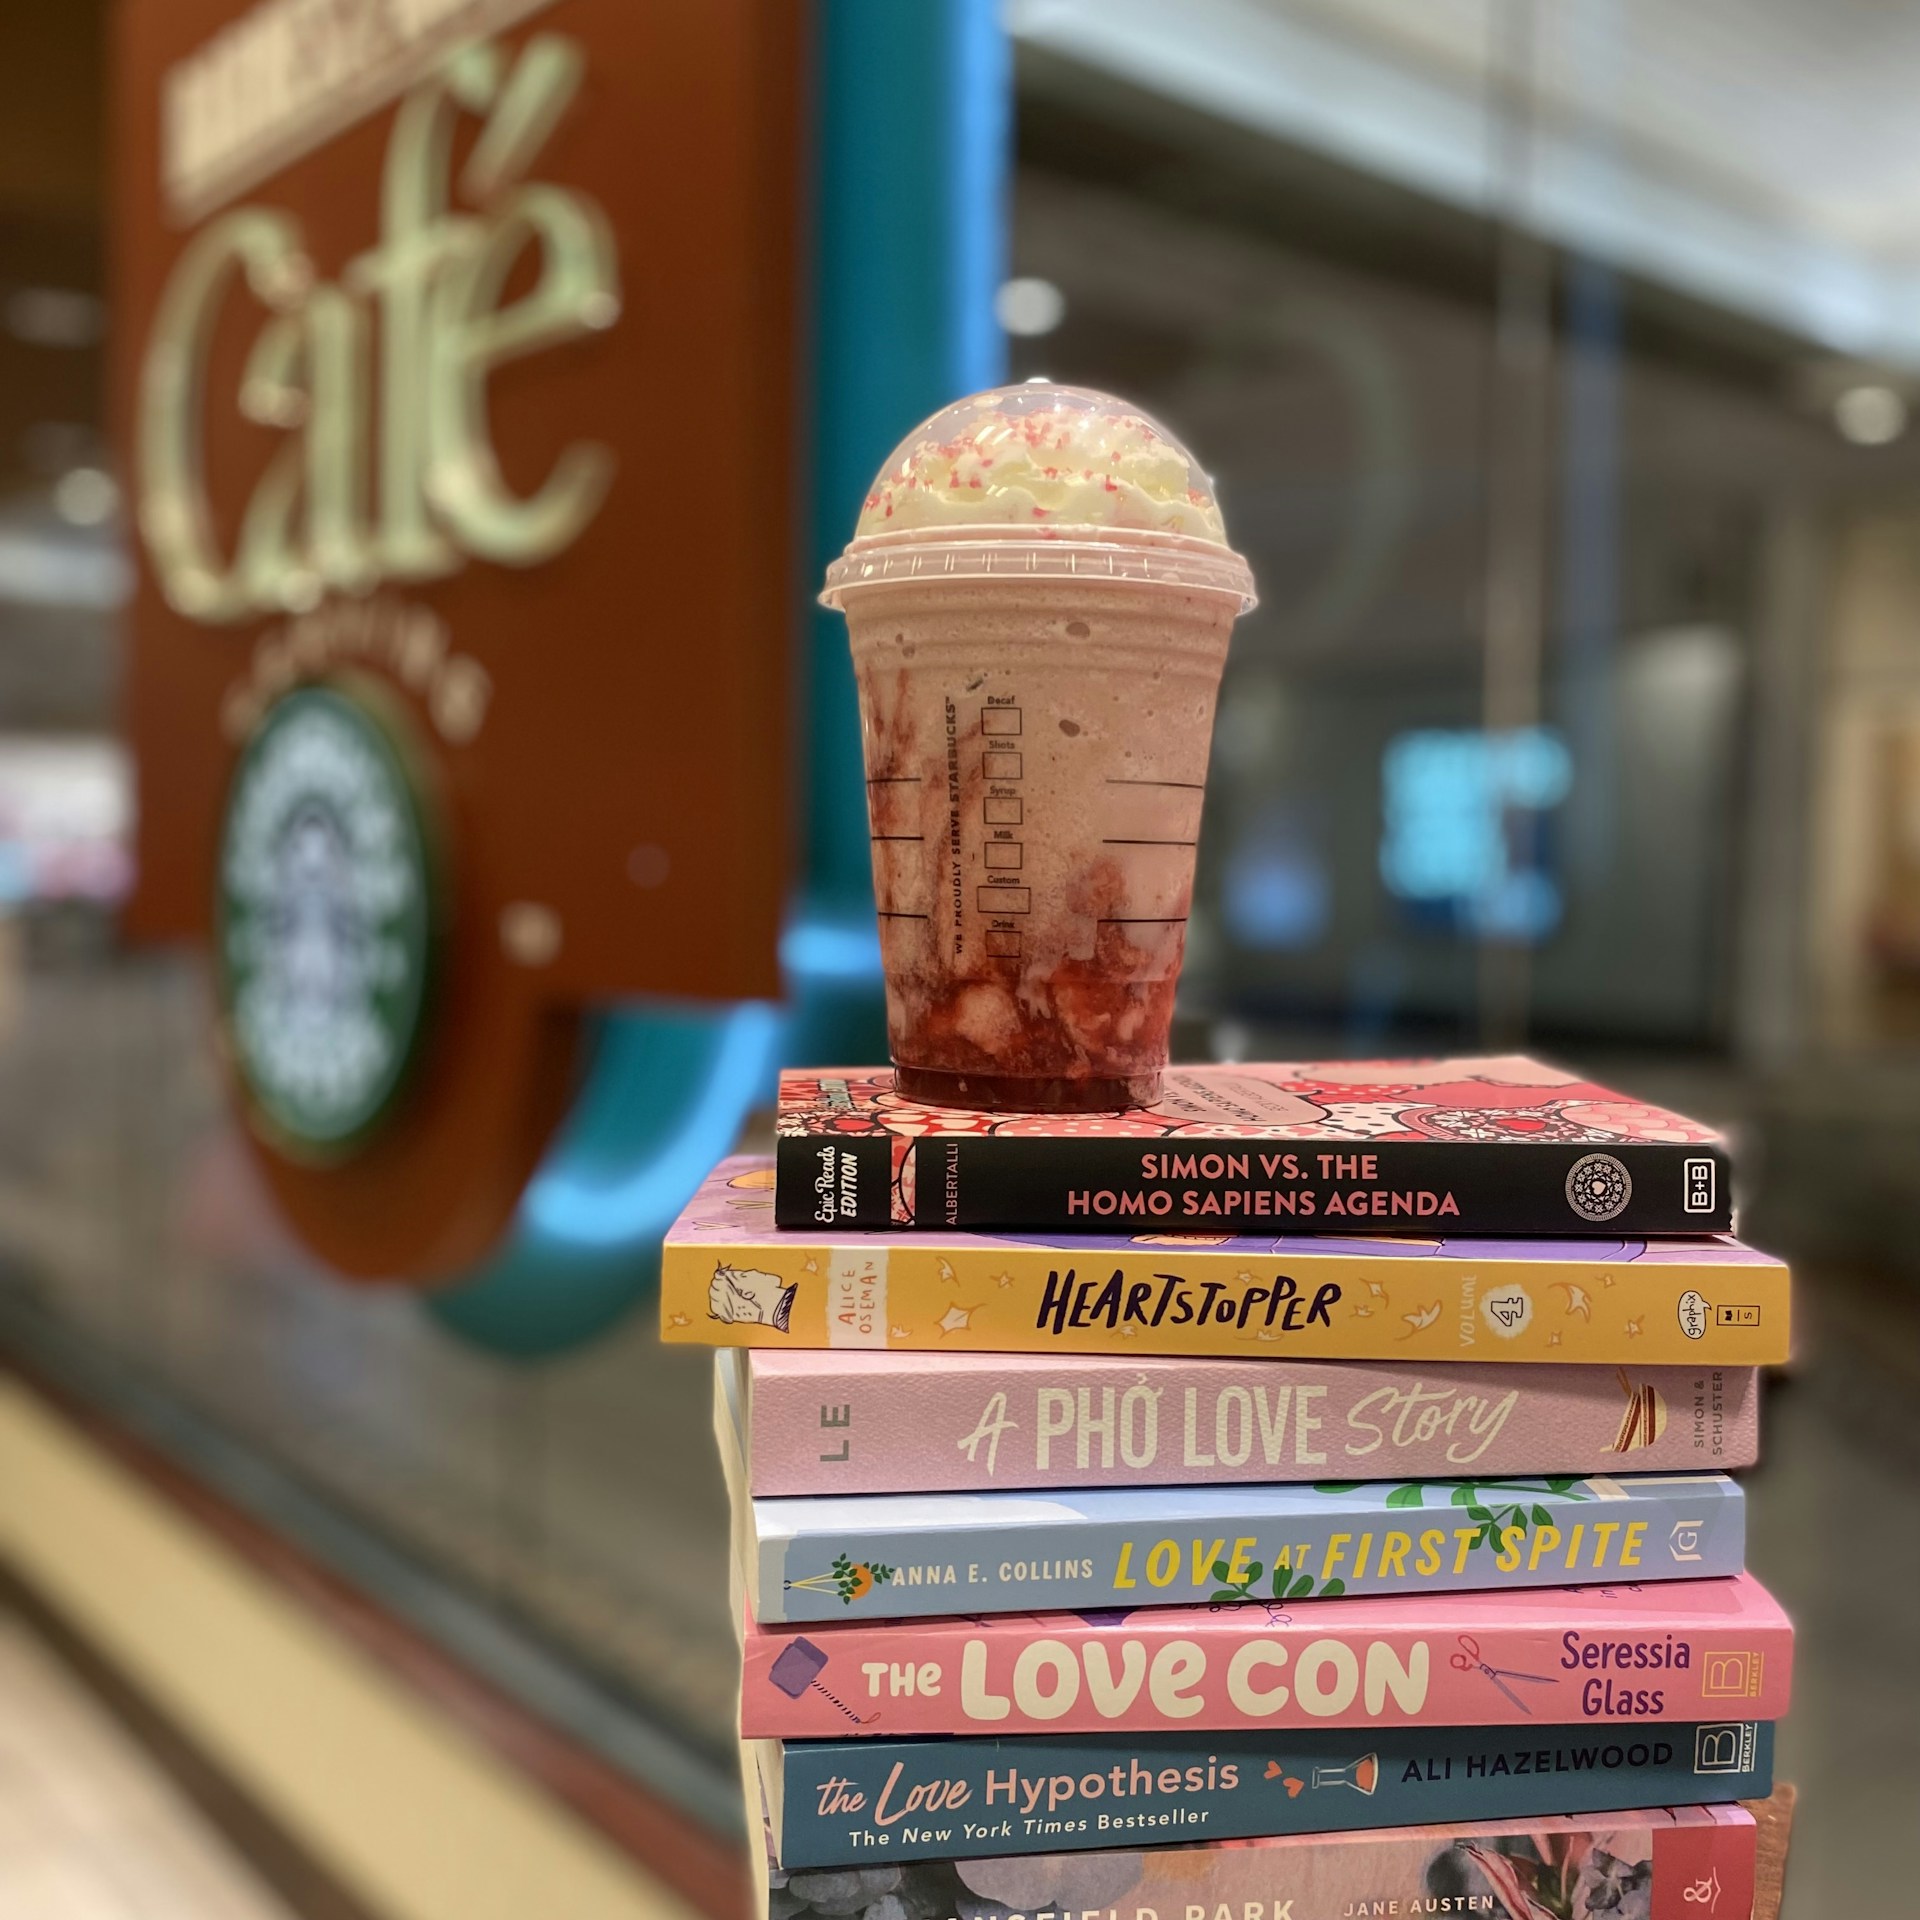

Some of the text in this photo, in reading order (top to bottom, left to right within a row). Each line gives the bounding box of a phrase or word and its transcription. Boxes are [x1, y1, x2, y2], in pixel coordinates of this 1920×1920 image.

[137, 28, 621, 626] Café
[987, 696, 1015, 705] Decaf
[988, 741, 1015, 750] Shots
[989, 786, 1016, 796] Syrup
[951, 810, 961, 855] SERVE
[993, 831, 1013, 840] Milk
[953, 861, 963, 927] PROUDLY
[987, 875, 1020, 885] Custom
[955, 934, 963, 954] WE
[991, 920, 1015, 929] Drink
[814, 1145, 838, 1223] Epic Reads
[840, 1152, 858, 1218] EDITION
[945, 1143, 959, 1225] ALBERTALLI
[1141, 1153, 1378, 1180] SIMON VS. THE
[1067, 1190, 1461, 1217] HOMO SAPIENS AGENDA
[838, 1269, 857, 1326] ALICE
[859, 1261, 878, 1334] OSEMAN
[1036, 1268, 1342, 1335] HEARTSTOPPER
[1459, 1274, 1477, 1347] VOLUME
[1490, 1297, 1524, 1327] 4
[1686, 1293, 1702, 1336] graphix
[820, 1404, 851, 1462] LE
[957, 1391, 1019, 1477] A
[1184, 1384, 1328, 1468] LOVE
[1344, 1381, 1520, 1464] Story
[1694, 1379, 1705, 1448] SIMON &
[1712, 1371, 1724, 1456] SCHUSTER
[891, 1558, 1093, 1587] ANNA E. COLLINS
[1113, 1521, 1649, 1589] LOVE AT FIRST SPITE
[1561, 1630, 1691, 1671] Seressia
[1226, 1638, 1430, 1718] CON
[1749, 1651, 1760, 1697] BERKLEY
[1581, 1678, 1665, 1717] Glass
[1401, 1741, 1674, 1783] ALI HAZELWOOD
[1742, 1723, 1753, 1773] BERKLEY
[816, 1754, 1240, 1828] the Love Hypothesis
[849, 1808, 1210, 1848] The New York Times Bestseller
[1185, 1900, 1296, 1920] PARK
[1343, 1895, 1494, 1917] JANE AUSTEN
